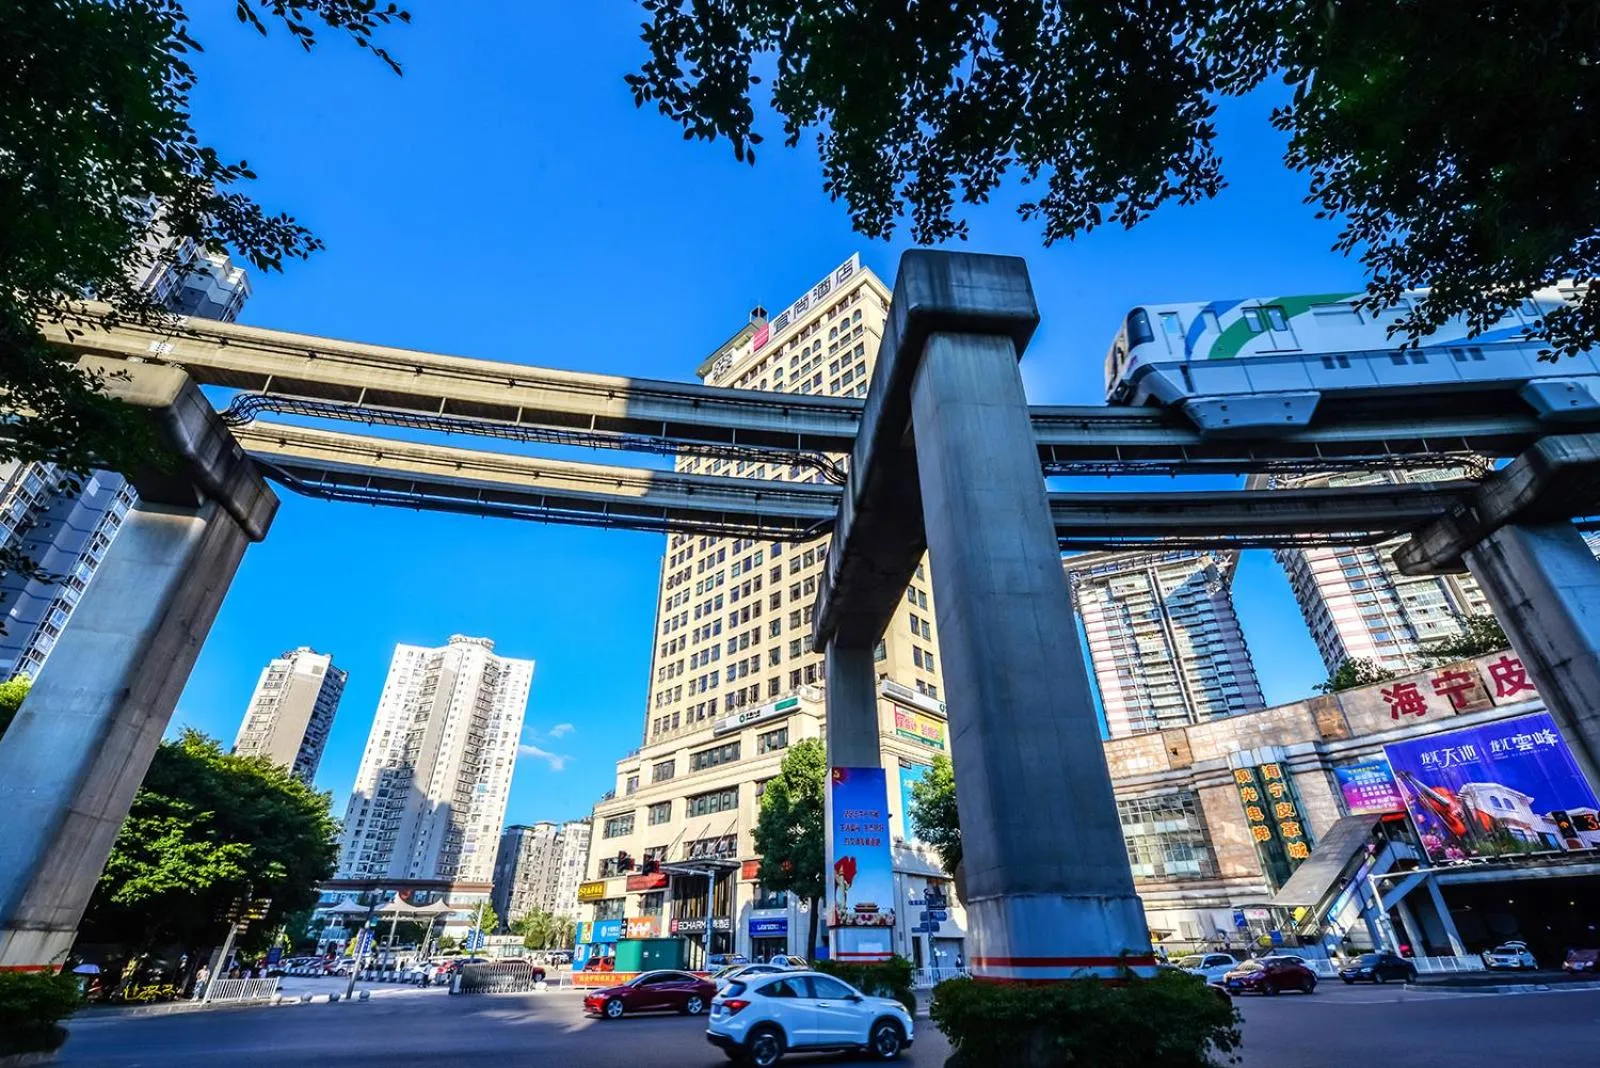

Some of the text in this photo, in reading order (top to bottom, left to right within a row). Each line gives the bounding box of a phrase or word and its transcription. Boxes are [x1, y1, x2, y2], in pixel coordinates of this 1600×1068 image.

[1380, 656, 1536, 720] 海宁皮
[1234, 769, 1272, 842] 观光电梯
[1261, 764, 1310, 859] 海宁皮革城
